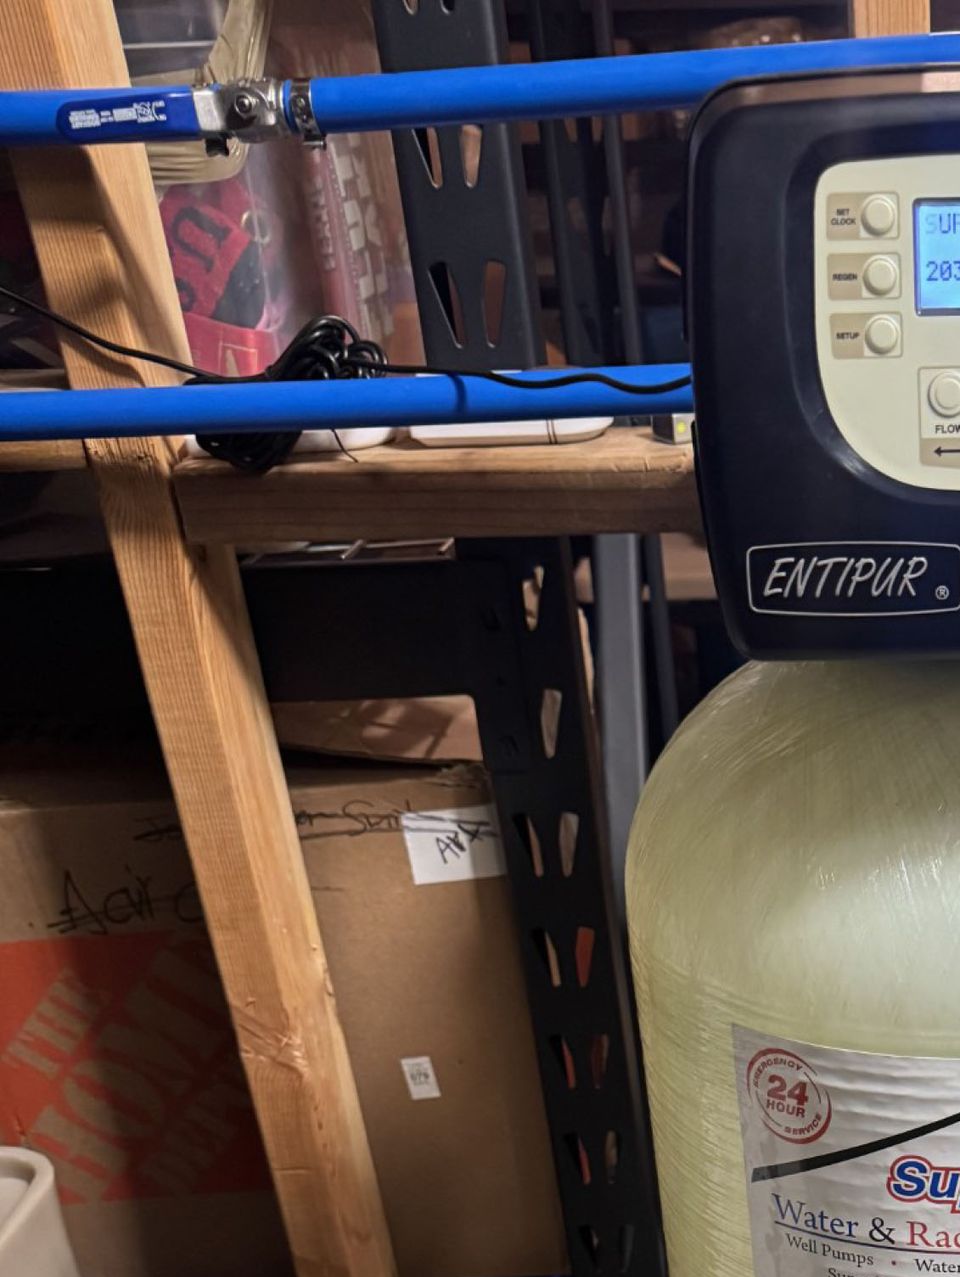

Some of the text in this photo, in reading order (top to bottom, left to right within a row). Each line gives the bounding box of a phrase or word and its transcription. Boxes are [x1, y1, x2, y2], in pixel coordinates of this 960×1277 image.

[831, 218, 856, 226] CLOCK
[832, 273, 858, 281] REGEN
[836, 332, 860, 340] SETUP
[763, 556, 928, 598] ENTIPUR
[767, 1074, 809, 1106] 24
[766, 1099, 806, 1118] HOUR
[772, 1192, 860, 1238] Water
[869, 1217, 896, 1244] &
[786, 1233, 817, 1254] Well
[822, 1244, 874, 1268] Pumps
